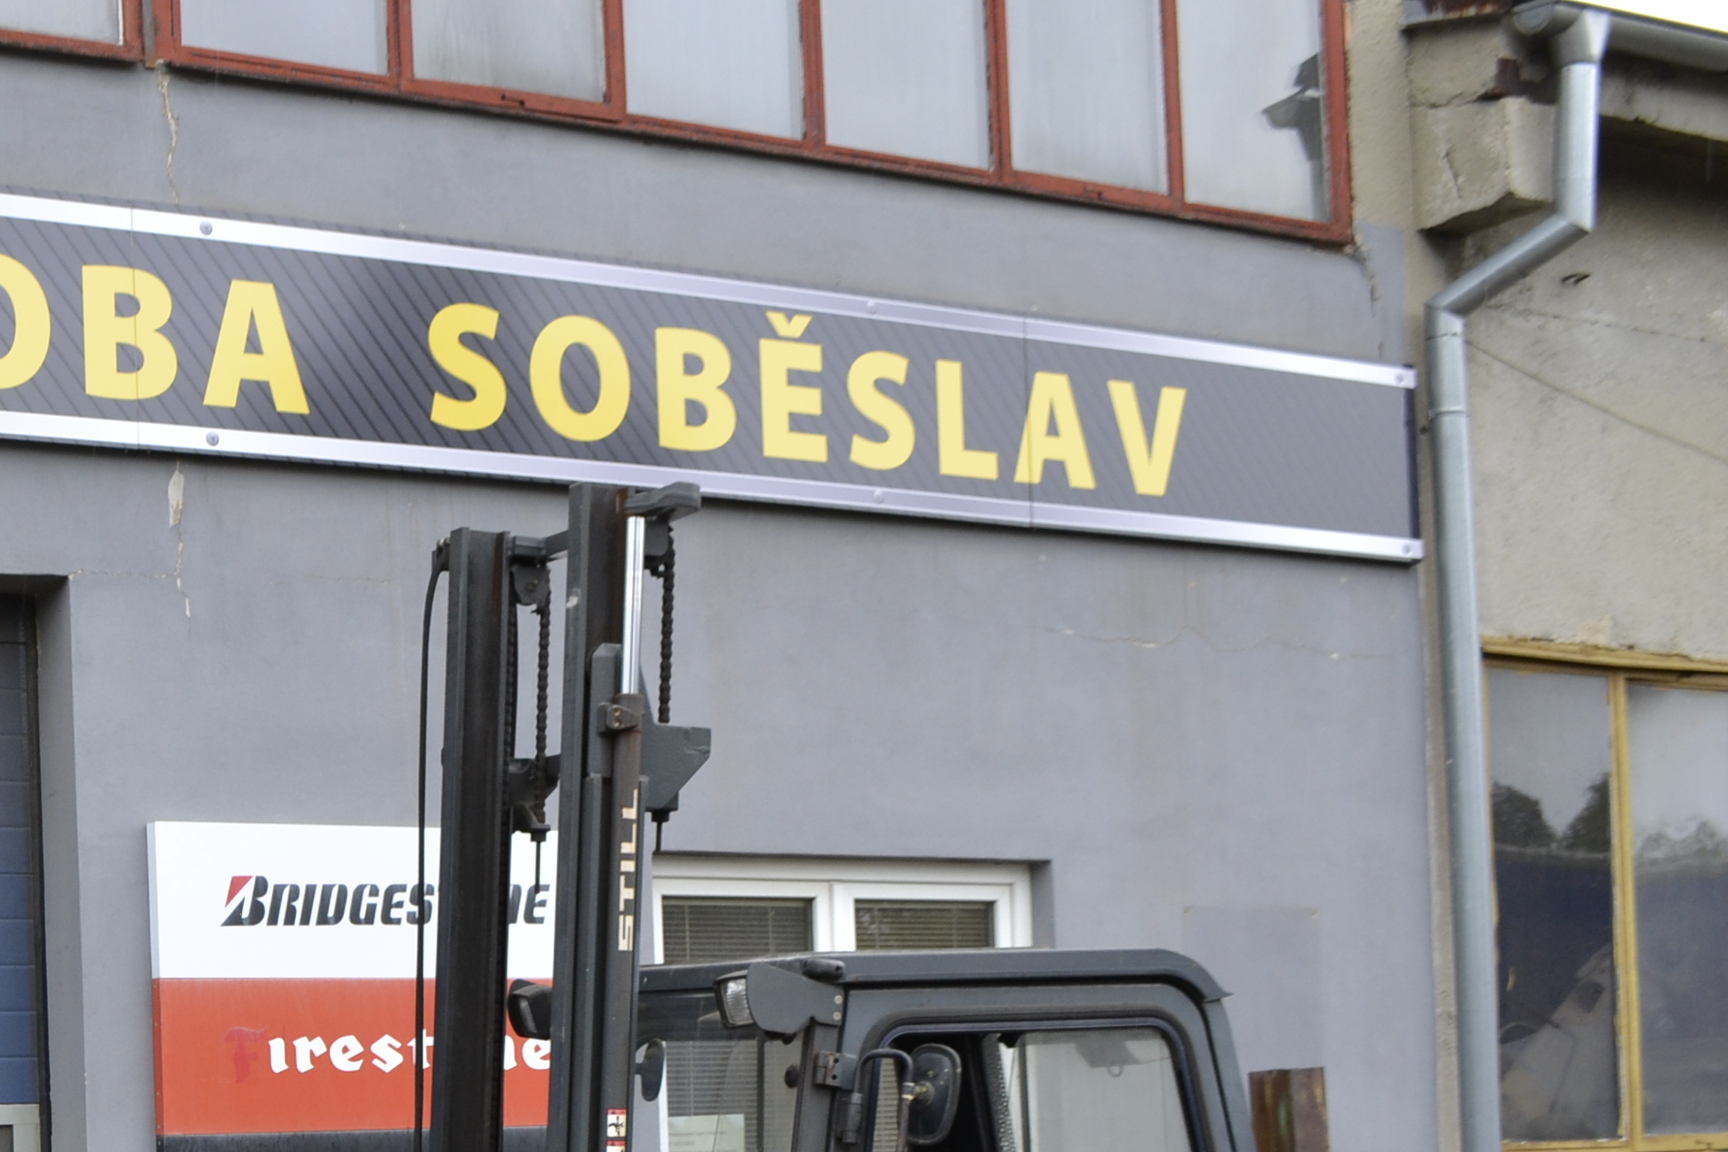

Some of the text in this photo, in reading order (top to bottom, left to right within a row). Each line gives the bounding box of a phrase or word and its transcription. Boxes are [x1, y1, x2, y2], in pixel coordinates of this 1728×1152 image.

[426, 302, 1187, 497] SOBĚSLAV
[220, 874, 551, 928] BRIDGESE
[618, 788, 639, 952] STILL
[223, 1025, 551, 1084] Fireste
